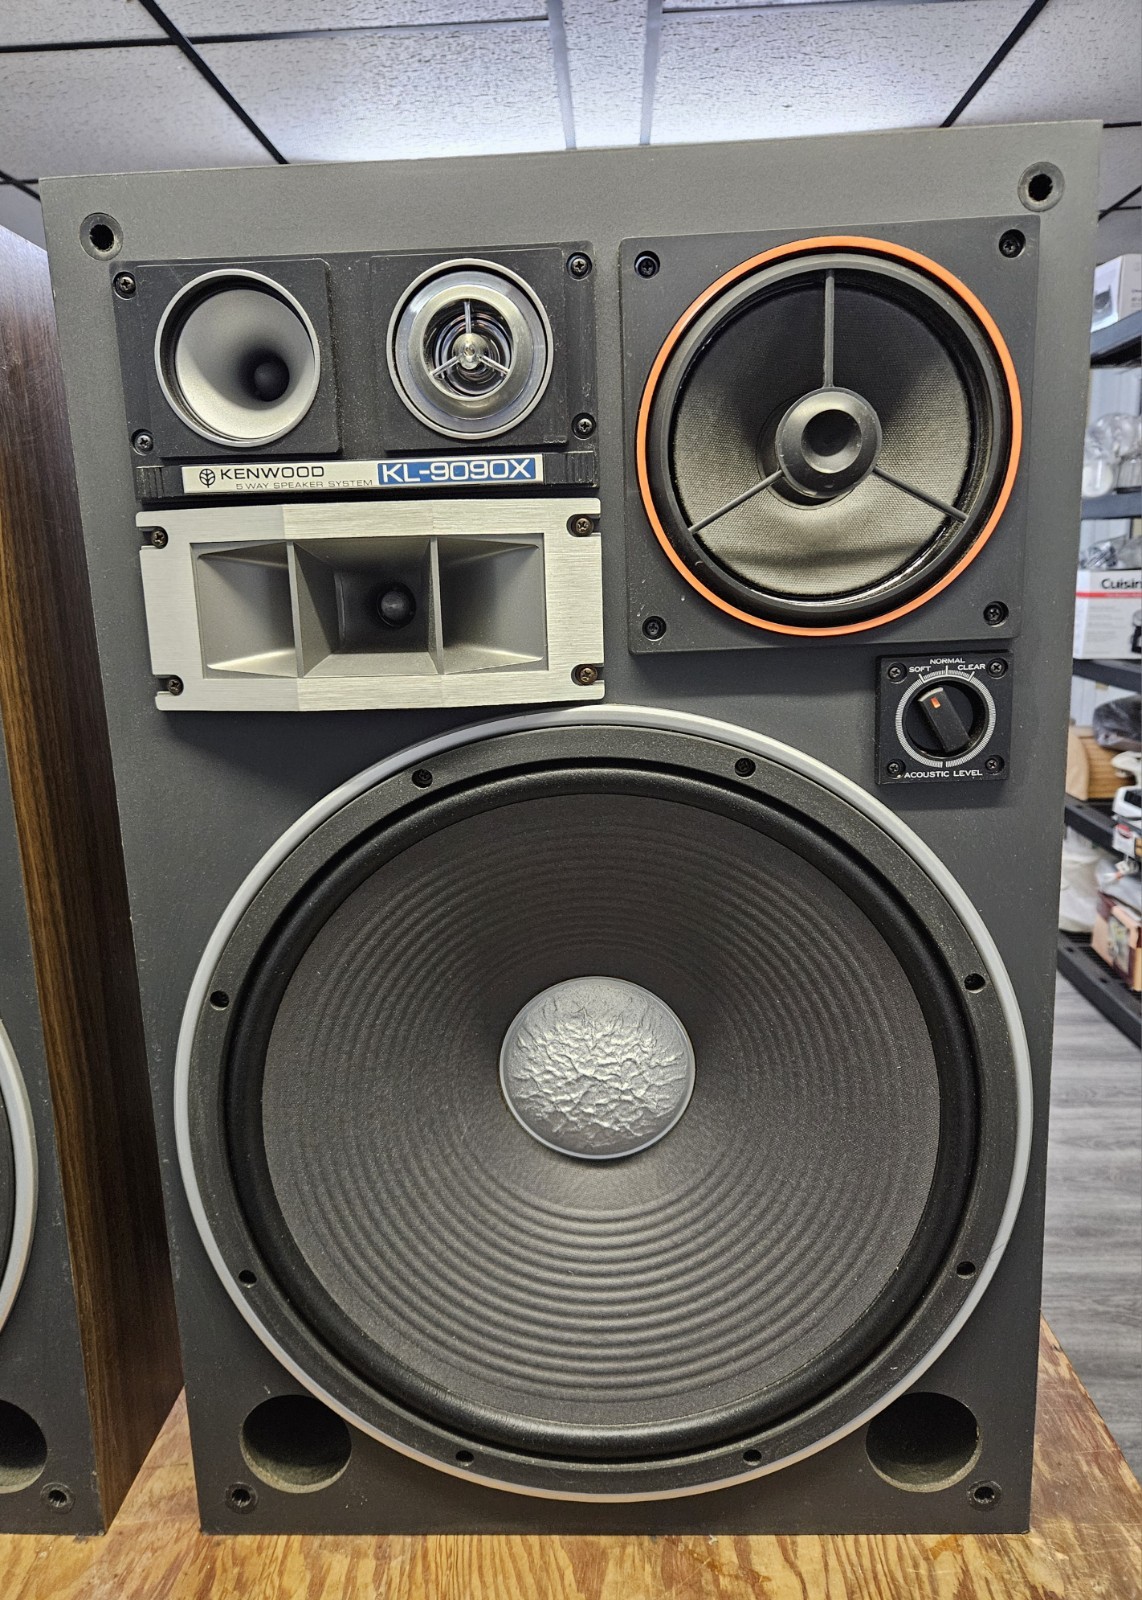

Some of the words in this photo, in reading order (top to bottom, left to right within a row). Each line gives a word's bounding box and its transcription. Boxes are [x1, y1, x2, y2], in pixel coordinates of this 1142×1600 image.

[220, 466, 325, 480] KENWOOD
[382, 458, 532, 483] KL-9090X
[245, 482, 269, 490] WAY
[273, 481, 323, 489] SPEAKER
[328, 479, 373, 488] SYSTEM
[929, 657, 966, 665] NORMAL
[908, 665, 931, 673] SOFT
[957, 663, 986, 671] CLEAR
[903, 770, 950, 779] ACOUSTIC
[953, 769, 983, 777] LEVEL
